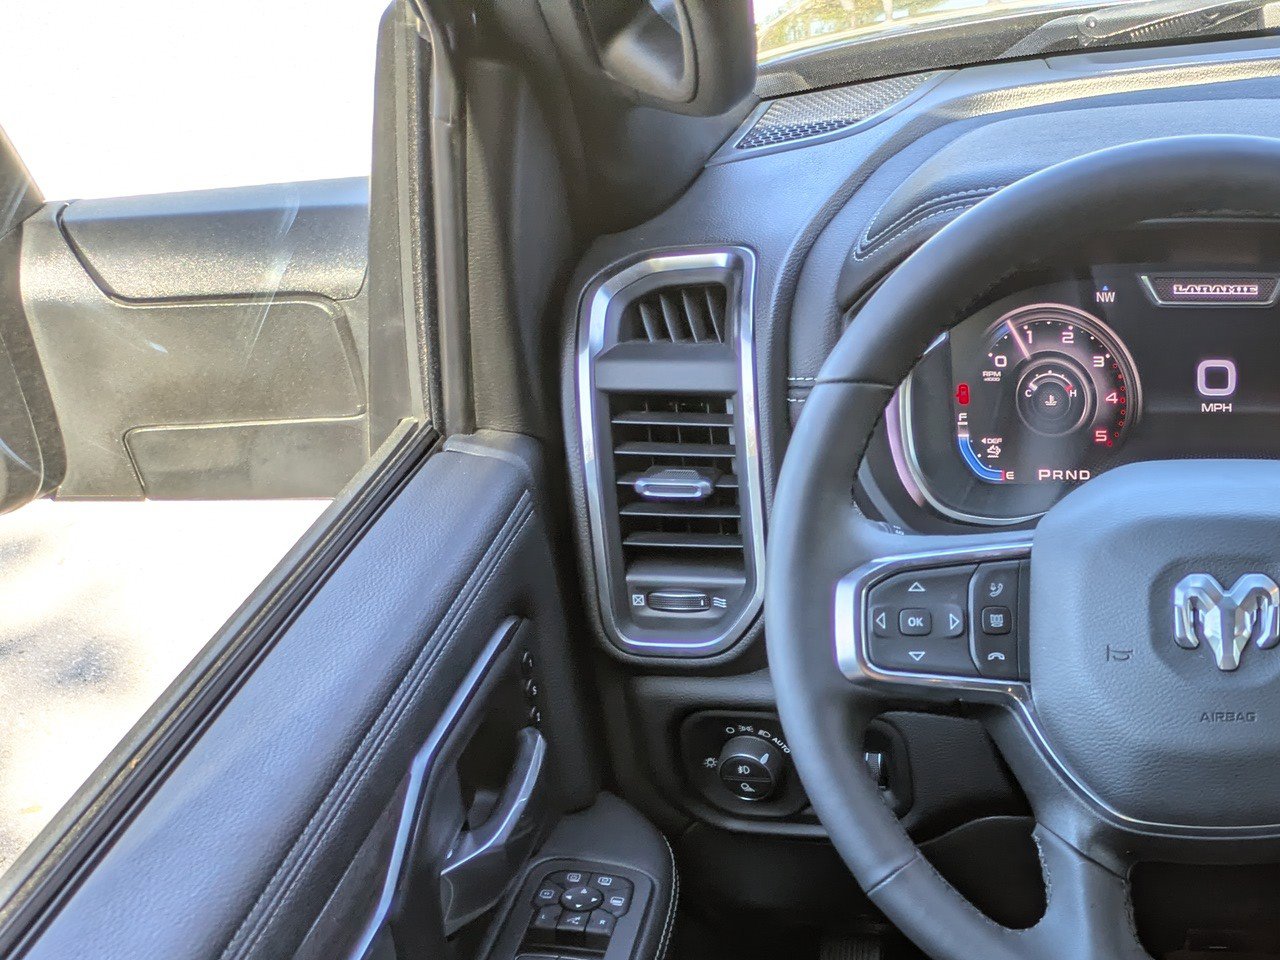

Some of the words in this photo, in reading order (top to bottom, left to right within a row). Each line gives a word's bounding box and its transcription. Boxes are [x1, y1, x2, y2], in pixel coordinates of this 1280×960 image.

[1173, 284, 1259, 295] LARAMIE
[1096, 292, 1116, 303] NW
[1026, 330, 1033, 344] 1
[1061, 331, 1074, 344] 2
[994, 355, 1007, 368] 0
[1093, 356, 1105, 368] 3
[1197, 359, 1237, 397] 0
[1105, 392, 1118, 404] 4
[1201, 403, 1233, 413] MPH
[958, 413, 968, 421] F
[1095, 430, 1107, 442] 5
[1006, 472, 1014, 480] E
[1038, 469, 1091, 481] PRND
[908, 616, 924, 627] OK
[1199, 711, 1257, 722] AIRBAG
[771, 737, 791, 754] AUTO
